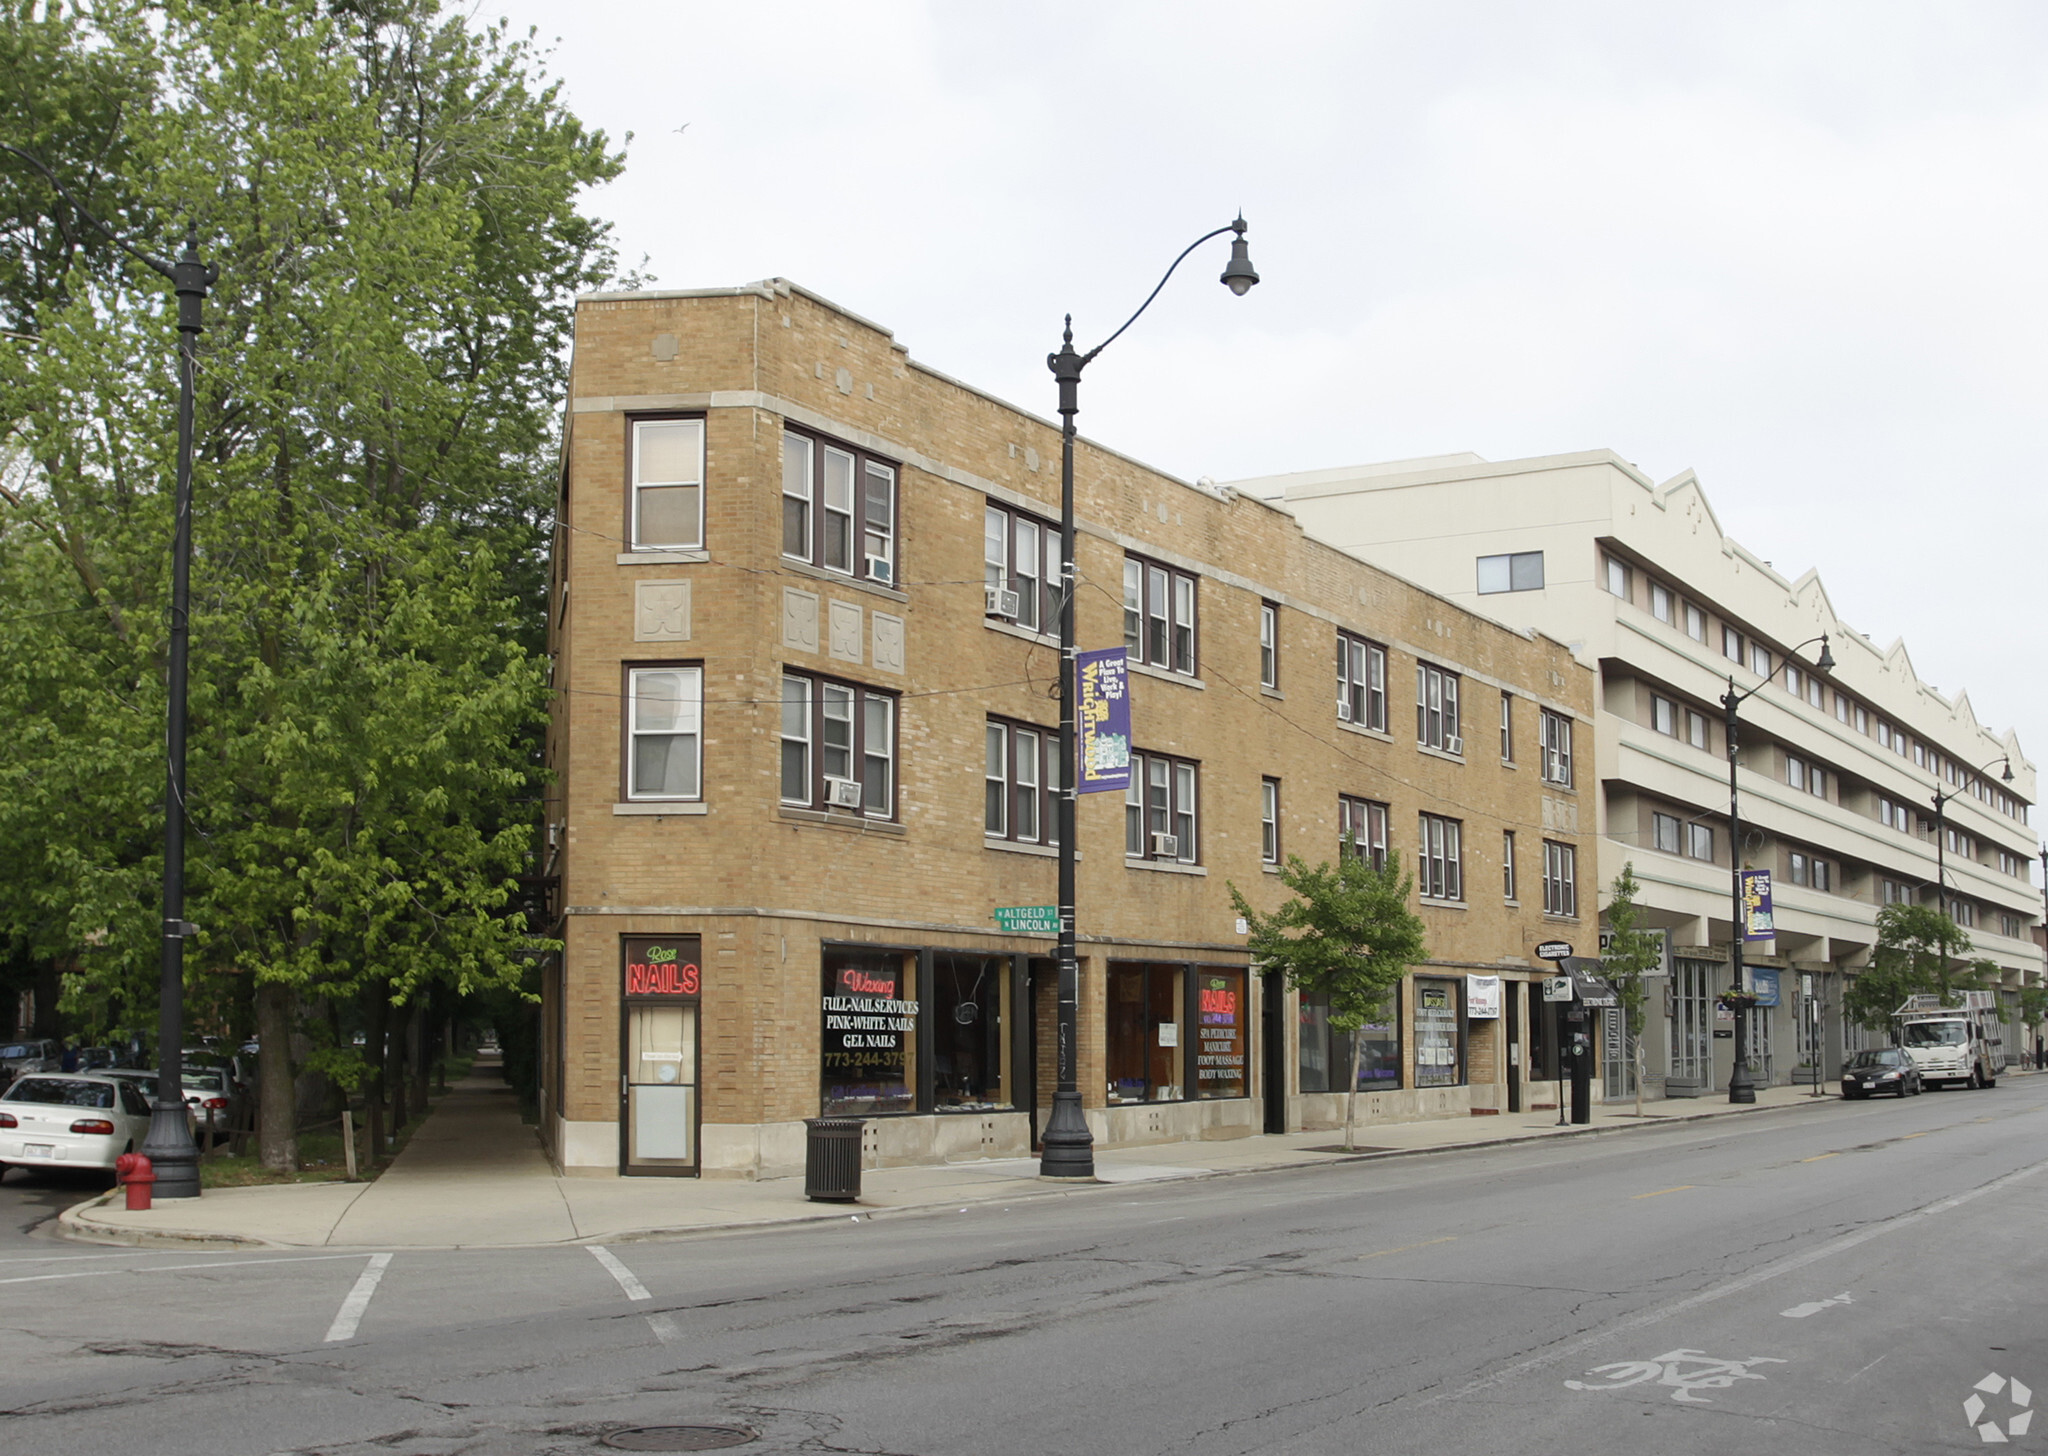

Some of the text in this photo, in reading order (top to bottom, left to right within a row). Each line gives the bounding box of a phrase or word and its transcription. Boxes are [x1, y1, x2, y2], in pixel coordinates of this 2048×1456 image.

[1004, 908, 1045, 919] ALTGELD
[1010, 919, 1050, 931] LINCOLN
[646, 946, 678, 964] Rose
[628, 963, 699, 995] NAILS
[843, 969, 896, 1000] Waxing
[1201, 988, 1236, 1015] NAILS
[888, 1017, 915, 1031] NAILS
[843, 1034, 896, 1048] GEL NAILS
[824, 1052, 915, 1068] 773-244-3797
[1197, 1055, 1244, 1066] FOOT MASSAGE
[1199, 1069, 1243, 1079] BODY WAXING
